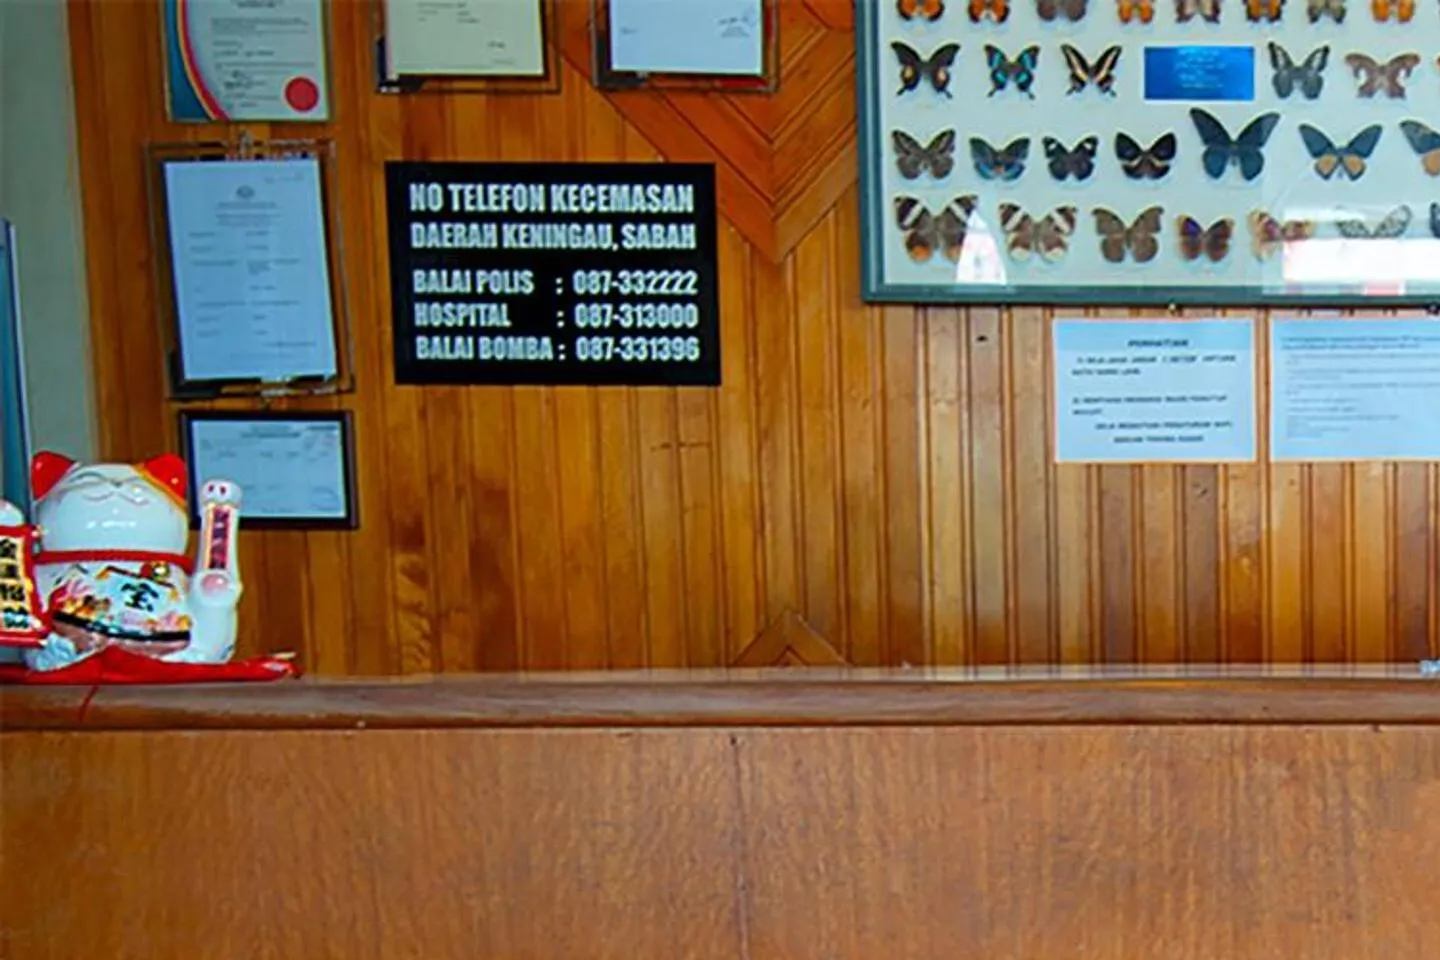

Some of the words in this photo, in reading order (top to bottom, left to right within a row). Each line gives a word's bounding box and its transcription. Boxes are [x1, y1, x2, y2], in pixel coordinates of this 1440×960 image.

[409, 183, 444, 213] NO
[447, 183, 546, 213] TELEFON
[550, 183, 695, 213] KECEMASAN
[410, 222, 498, 249] DAERAH
[502, 223, 619, 251] KENINGAU,
[620, 223, 697, 249] SABAH
[413, 269, 471, 294] BALAI
[475, 270, 535, 294] POLIS
[572, 270, 699, 294] 087-332222
[413, 302, 512, 327] HOSPITAL
[574, 303, 699, 328] 087-313000
[416, 336, 474, 360] BALAI
[478, 336, 553, 361] BOMBA
[575, 336, 700, 361] 087-331396
